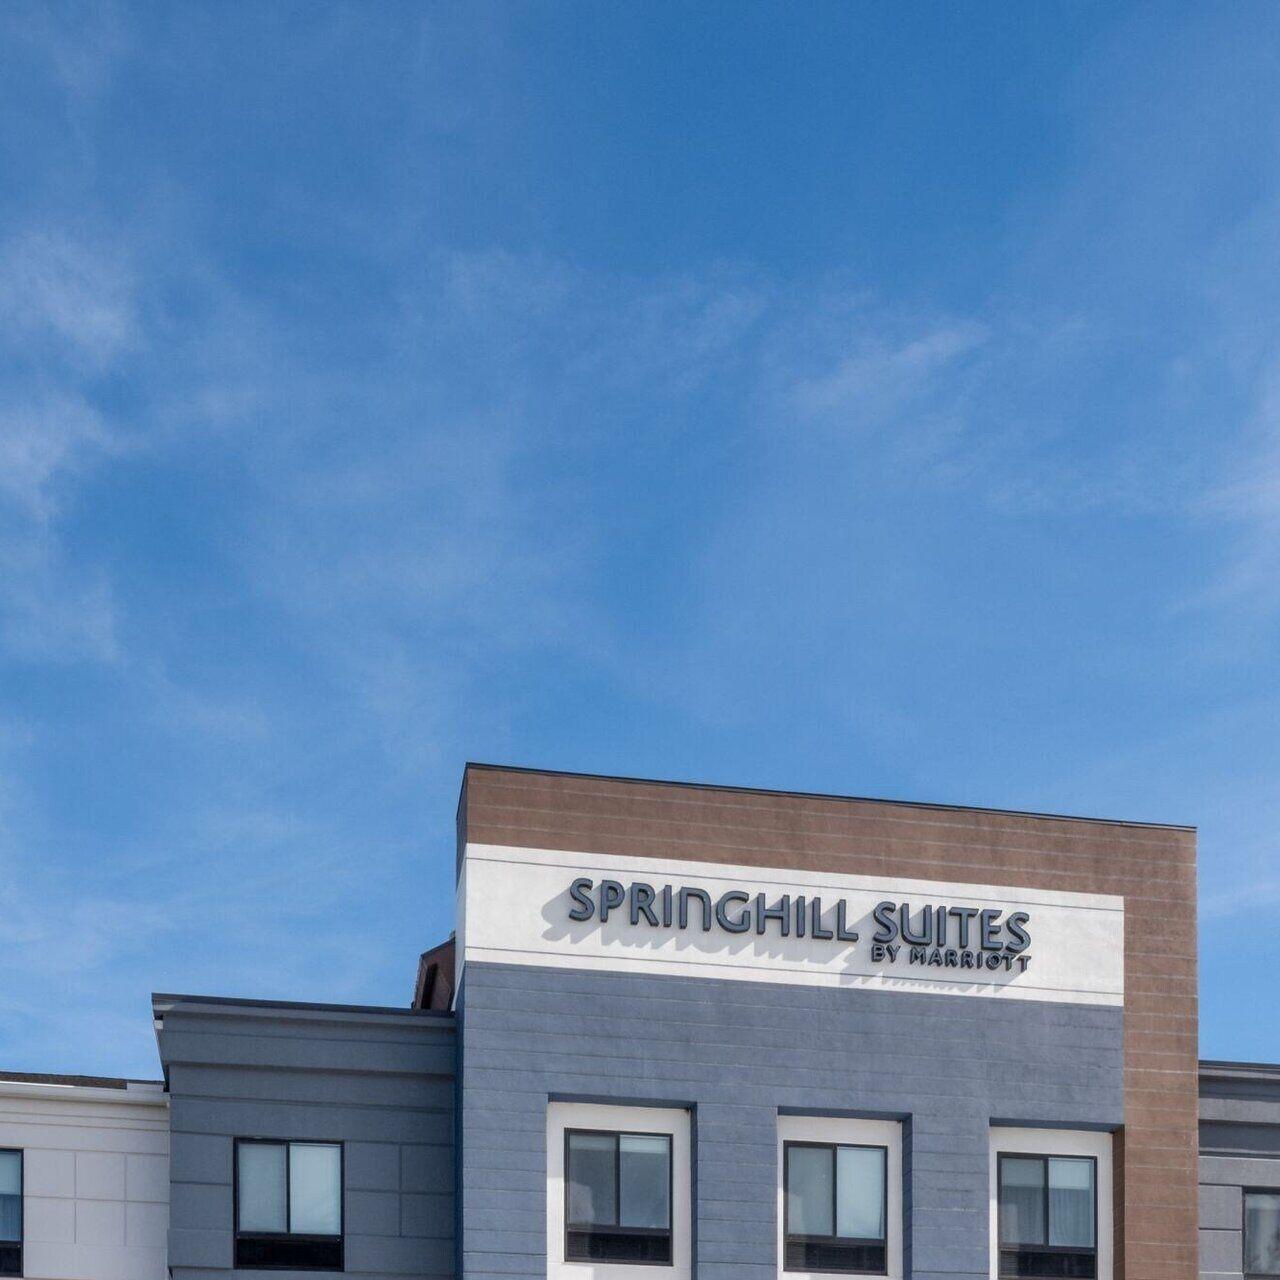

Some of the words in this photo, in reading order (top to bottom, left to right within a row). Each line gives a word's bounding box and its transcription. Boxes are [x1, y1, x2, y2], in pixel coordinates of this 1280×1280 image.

[569, 878, 858, 942] SPRINGHILL
[873, 901, 1031, 954] SUITES
[872, 944, 901, 963] BY
[910, 947, 1032, 972] MARRIOTT
